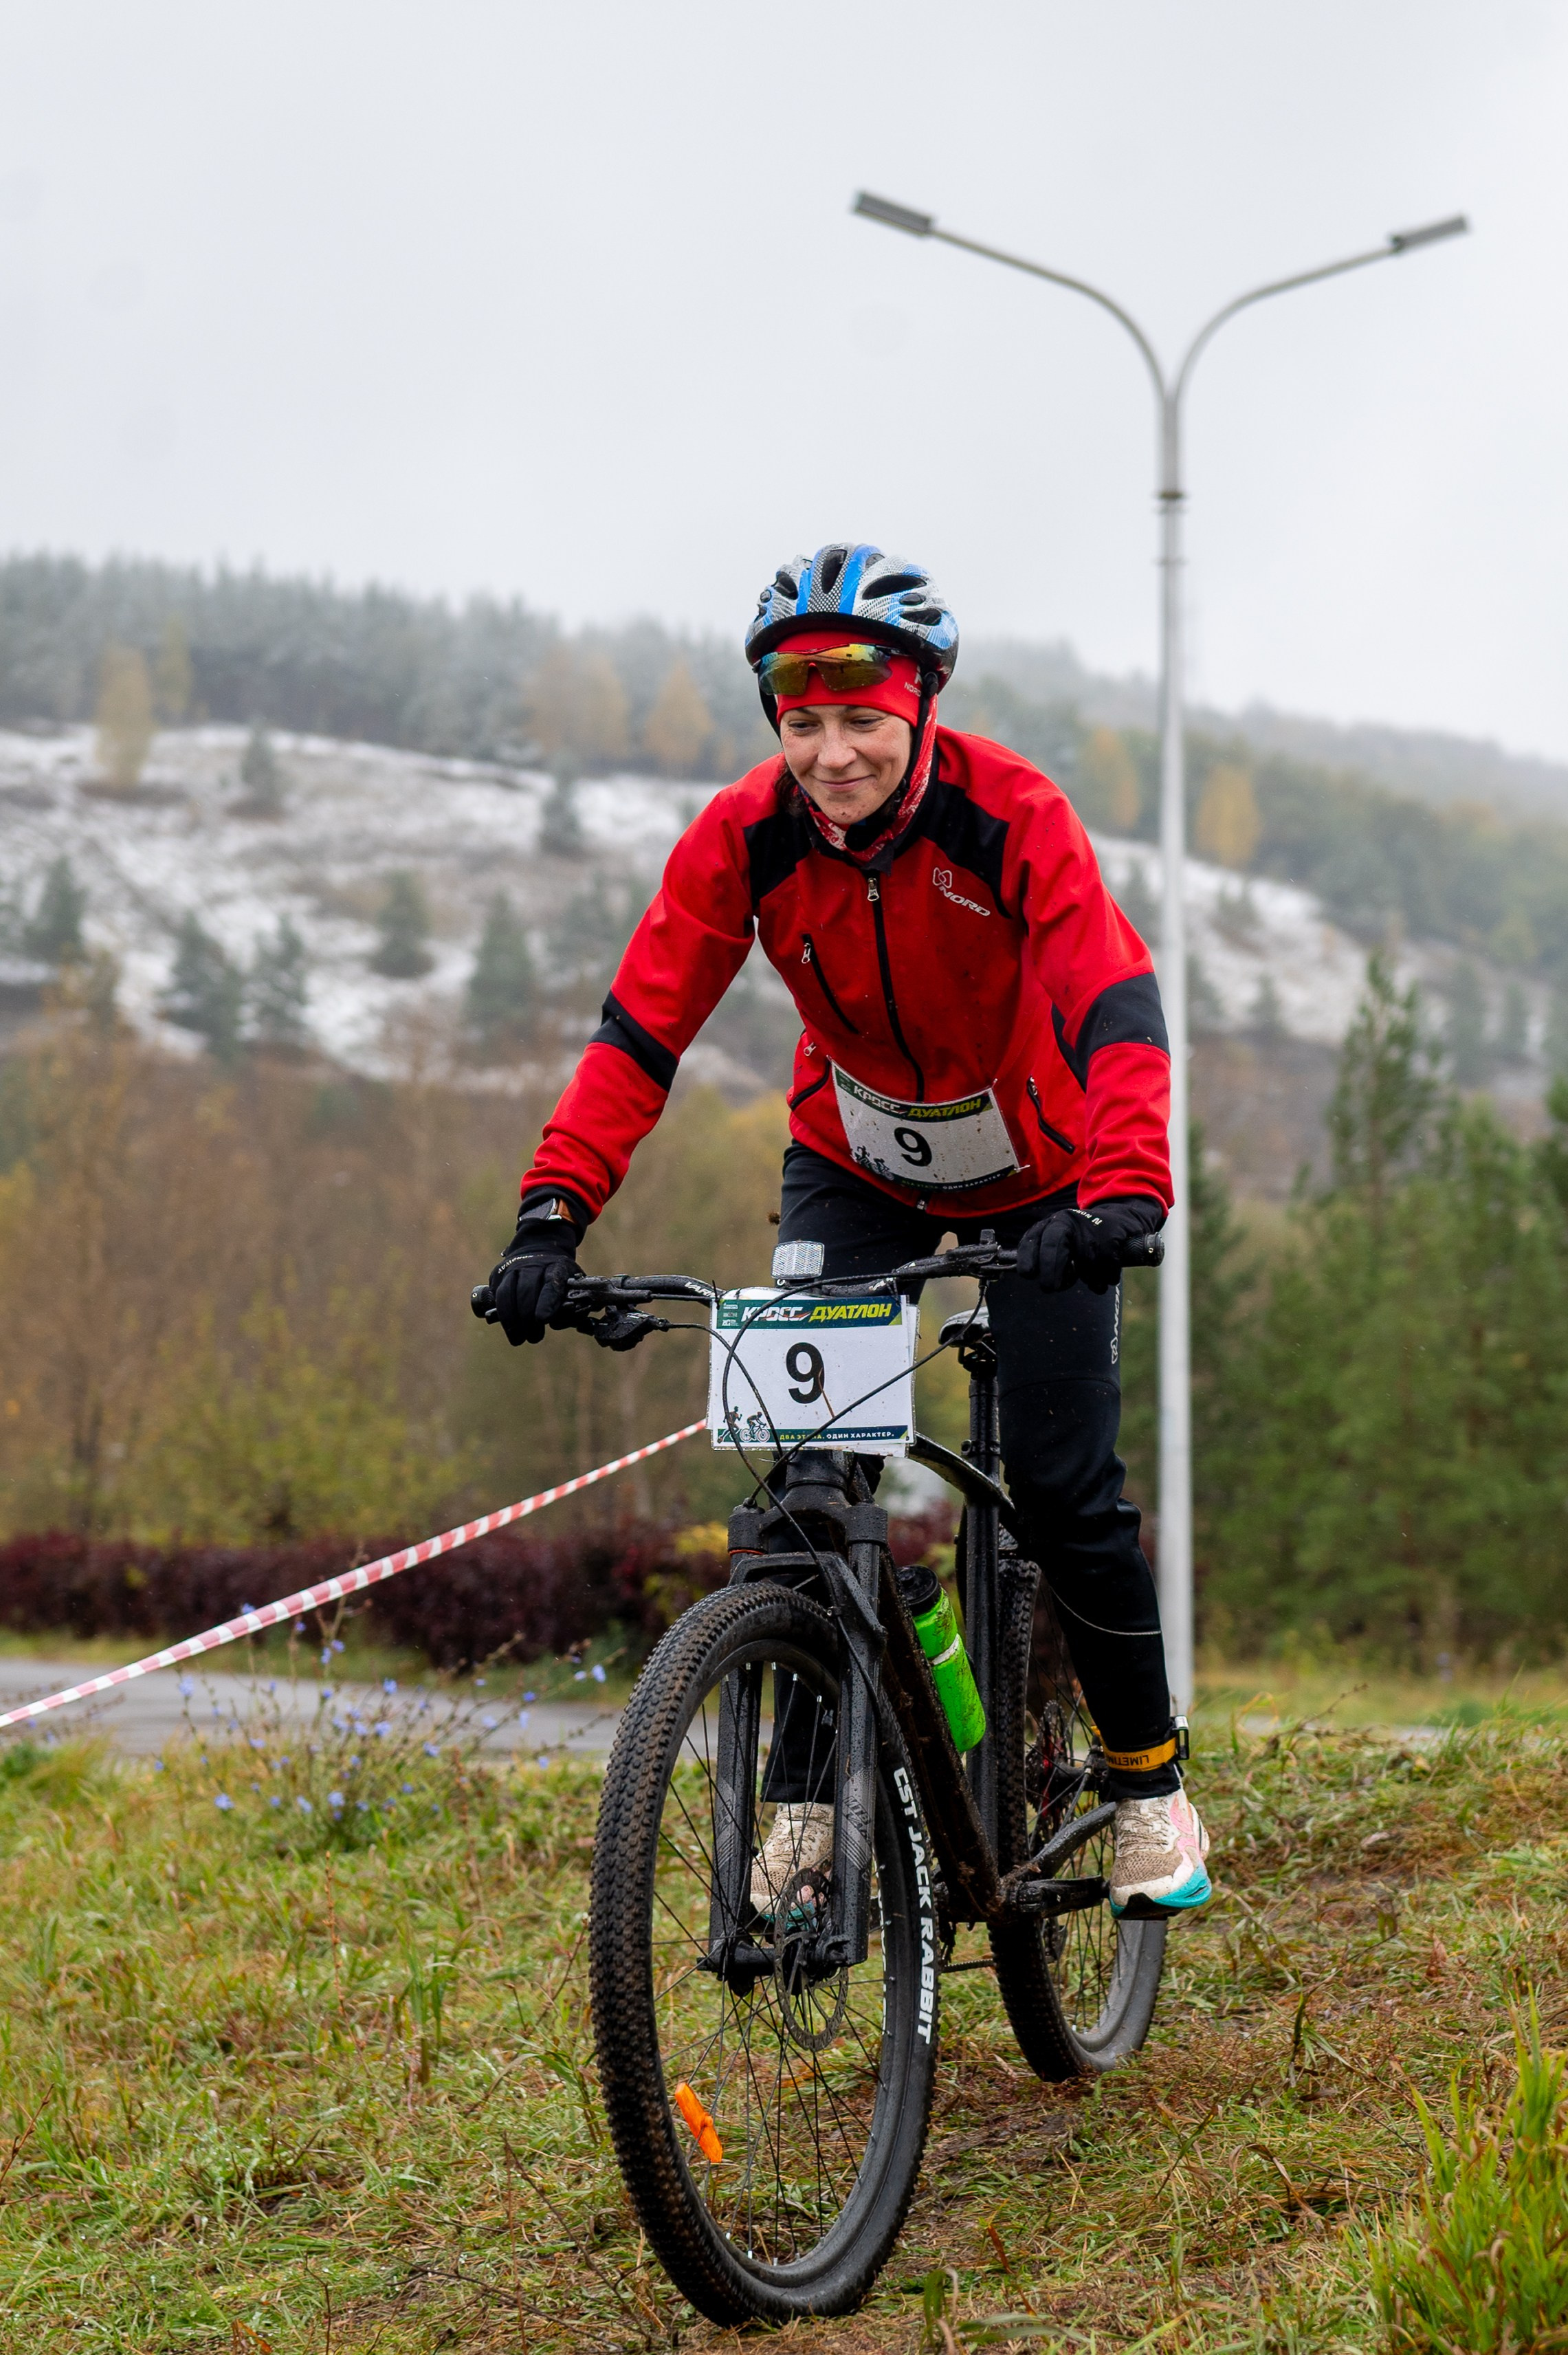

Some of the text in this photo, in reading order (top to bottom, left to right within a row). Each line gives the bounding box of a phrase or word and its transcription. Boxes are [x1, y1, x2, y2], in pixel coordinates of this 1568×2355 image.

[904, 681, 921, 697] NORD
[939, 886, 991, 916] NORD
[854, 1086, 982, 1118] КРОСС ДУАТЛОН
[894, 1127, 932, 1166] 9
[741, 1306, 806, 1322] КРОСС
[808, 1303, 892, 1322] ДУАТЛОН
[786, 1342, 825, 1404] 9
[894, 1766, 934, 2045] CST JACK RABBIT
